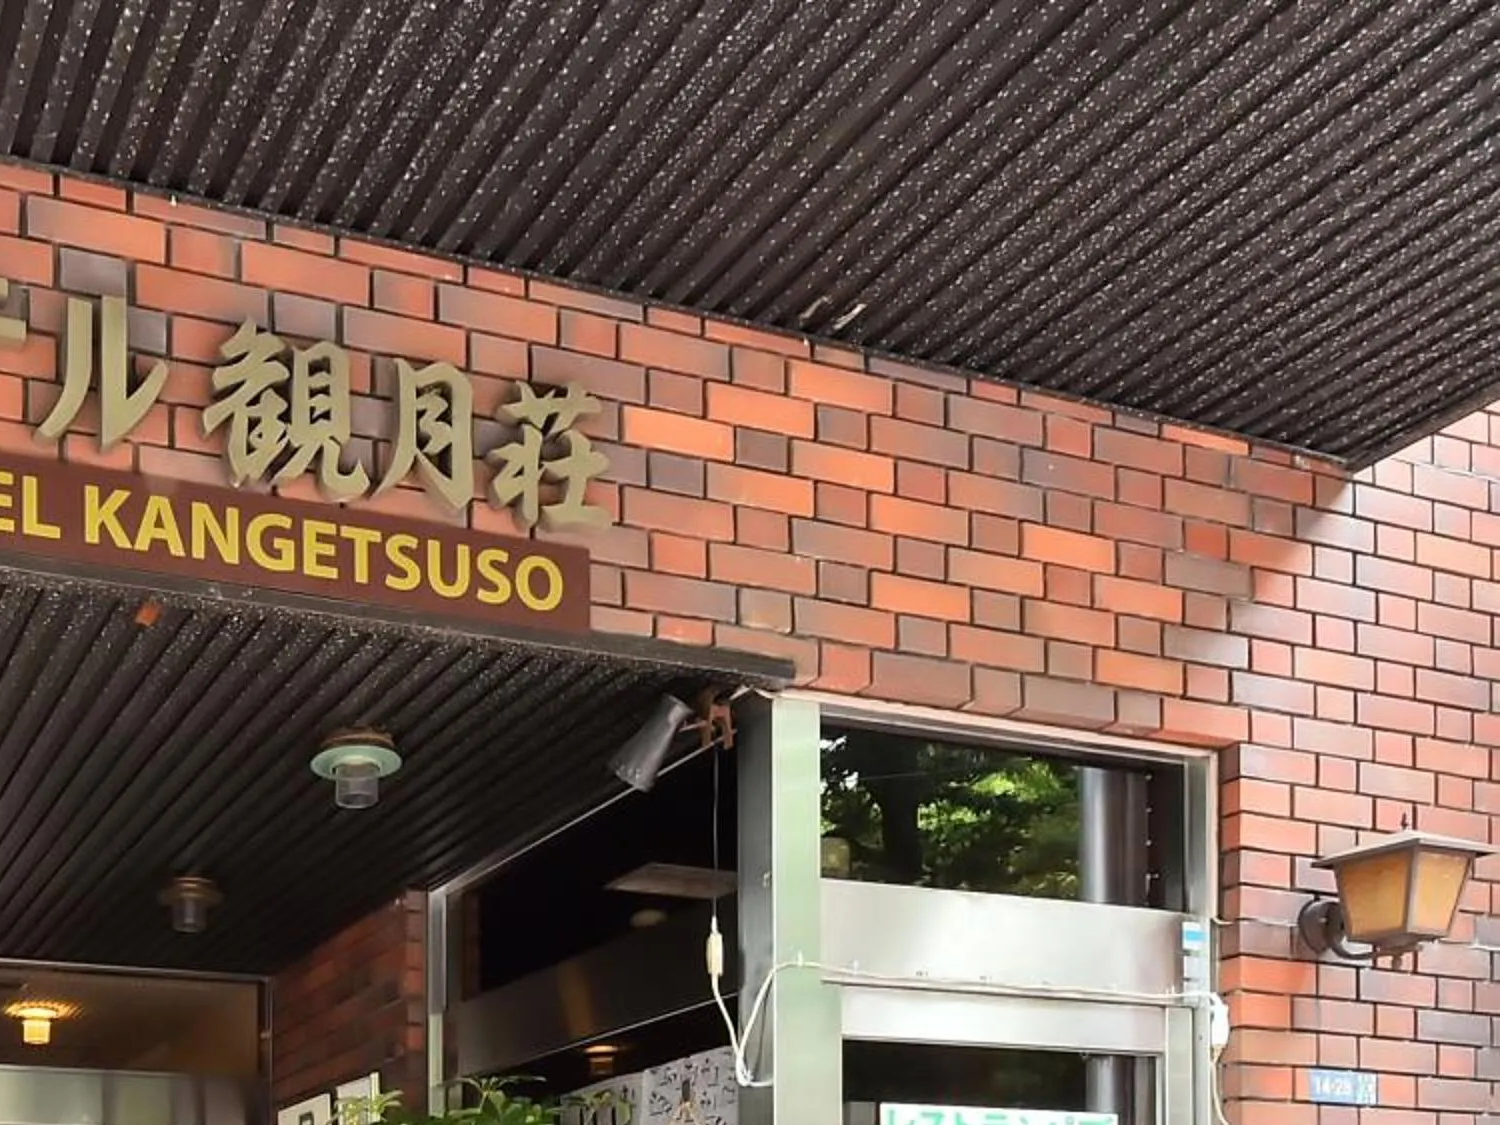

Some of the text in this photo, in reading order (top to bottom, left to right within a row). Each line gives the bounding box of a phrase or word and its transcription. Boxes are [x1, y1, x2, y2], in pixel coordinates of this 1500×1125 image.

[203, 317, 613, 533] 観月荘
[84, 487, 564, 612] KANGETSUSO
